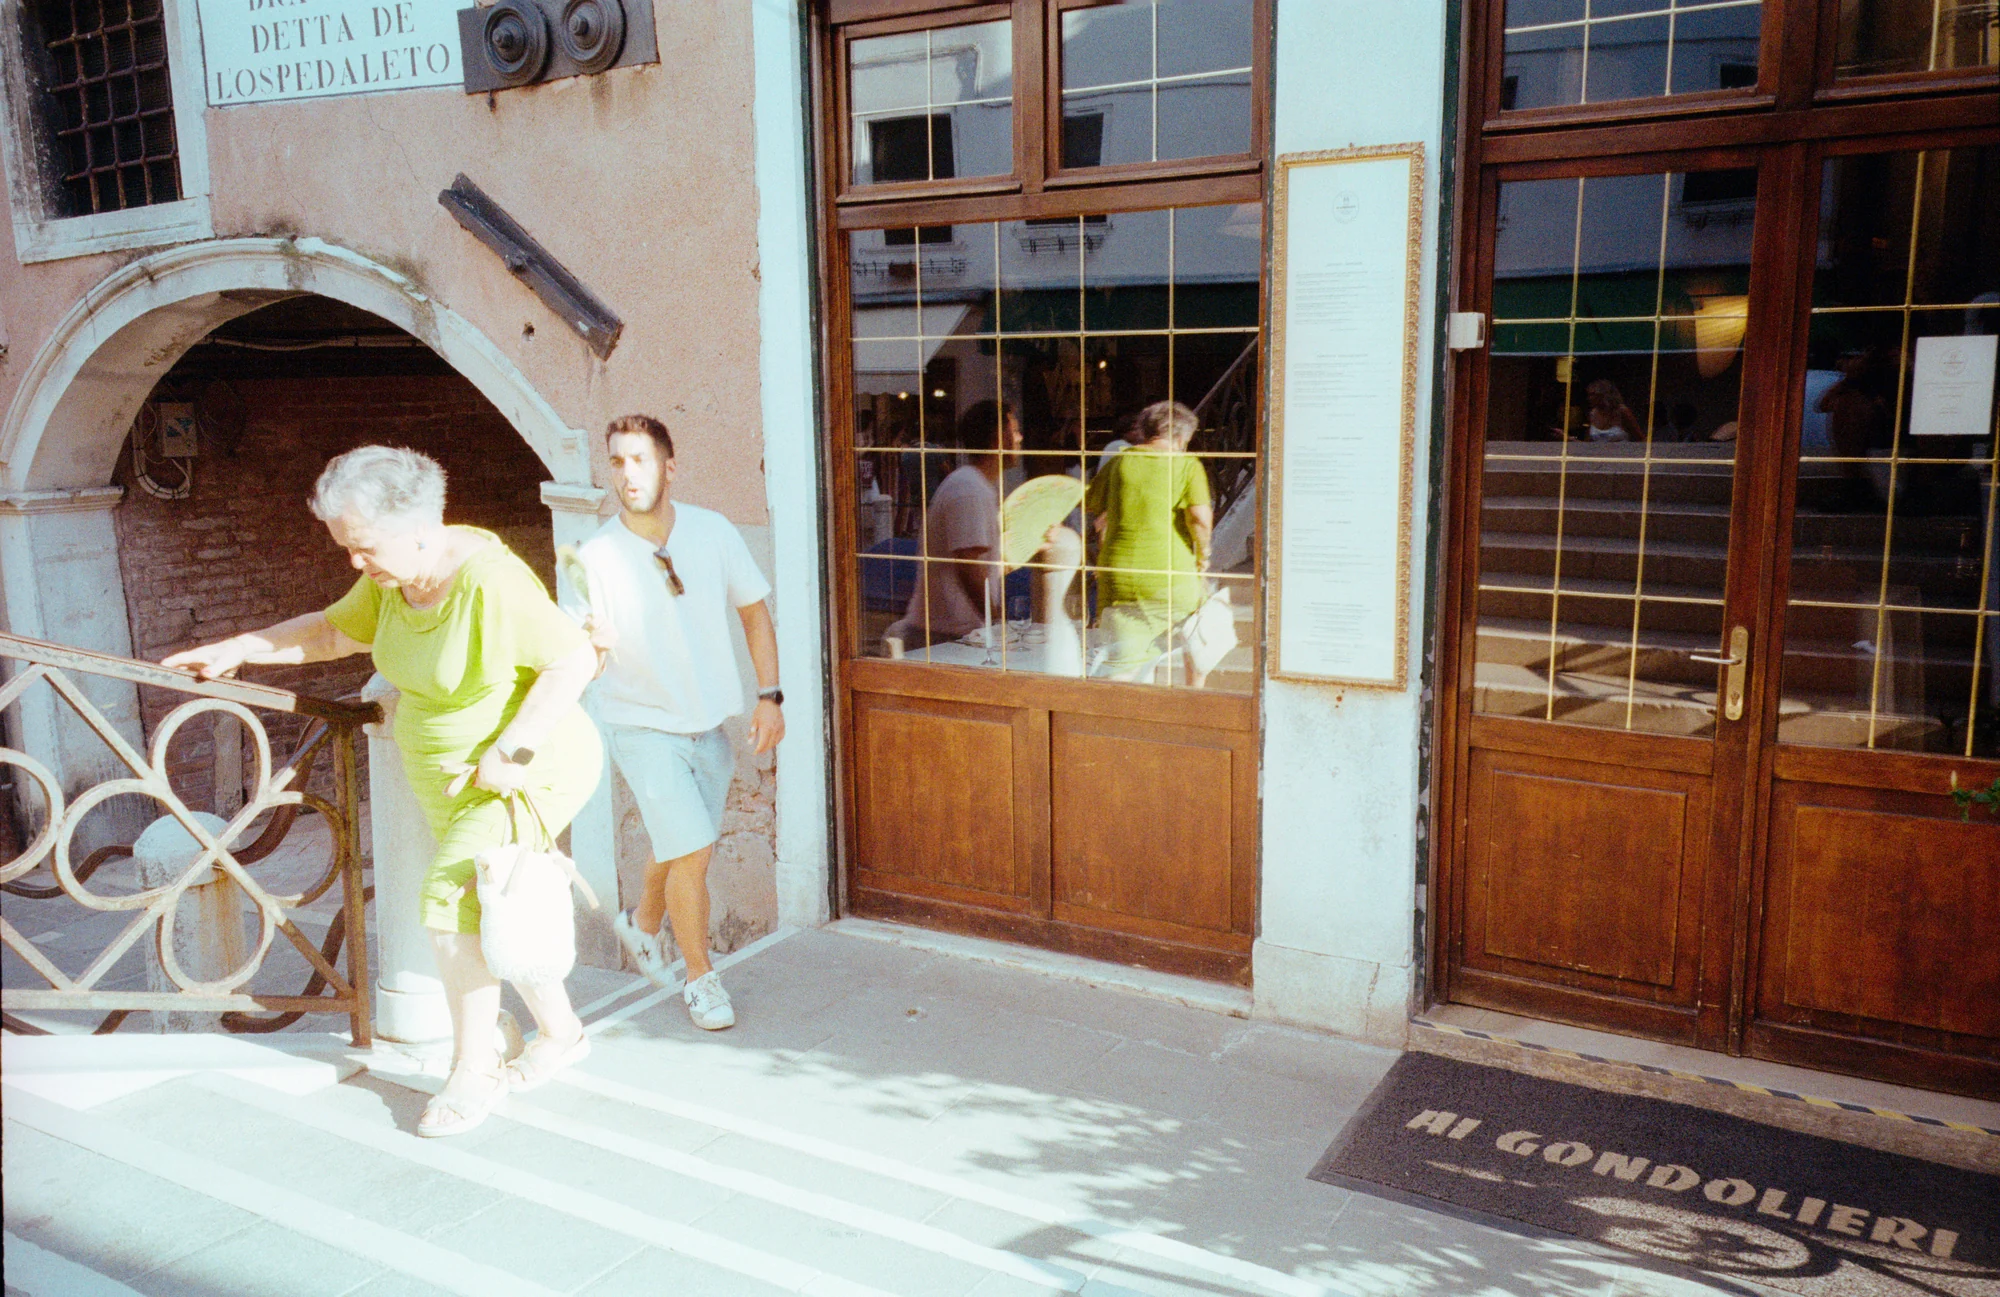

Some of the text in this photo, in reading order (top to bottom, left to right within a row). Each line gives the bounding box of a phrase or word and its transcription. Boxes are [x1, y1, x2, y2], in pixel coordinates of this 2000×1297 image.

[251, 2, 415, 53] DETTA DE
[1405, 1109, 1959, 1258] AI GONDOLIERI
